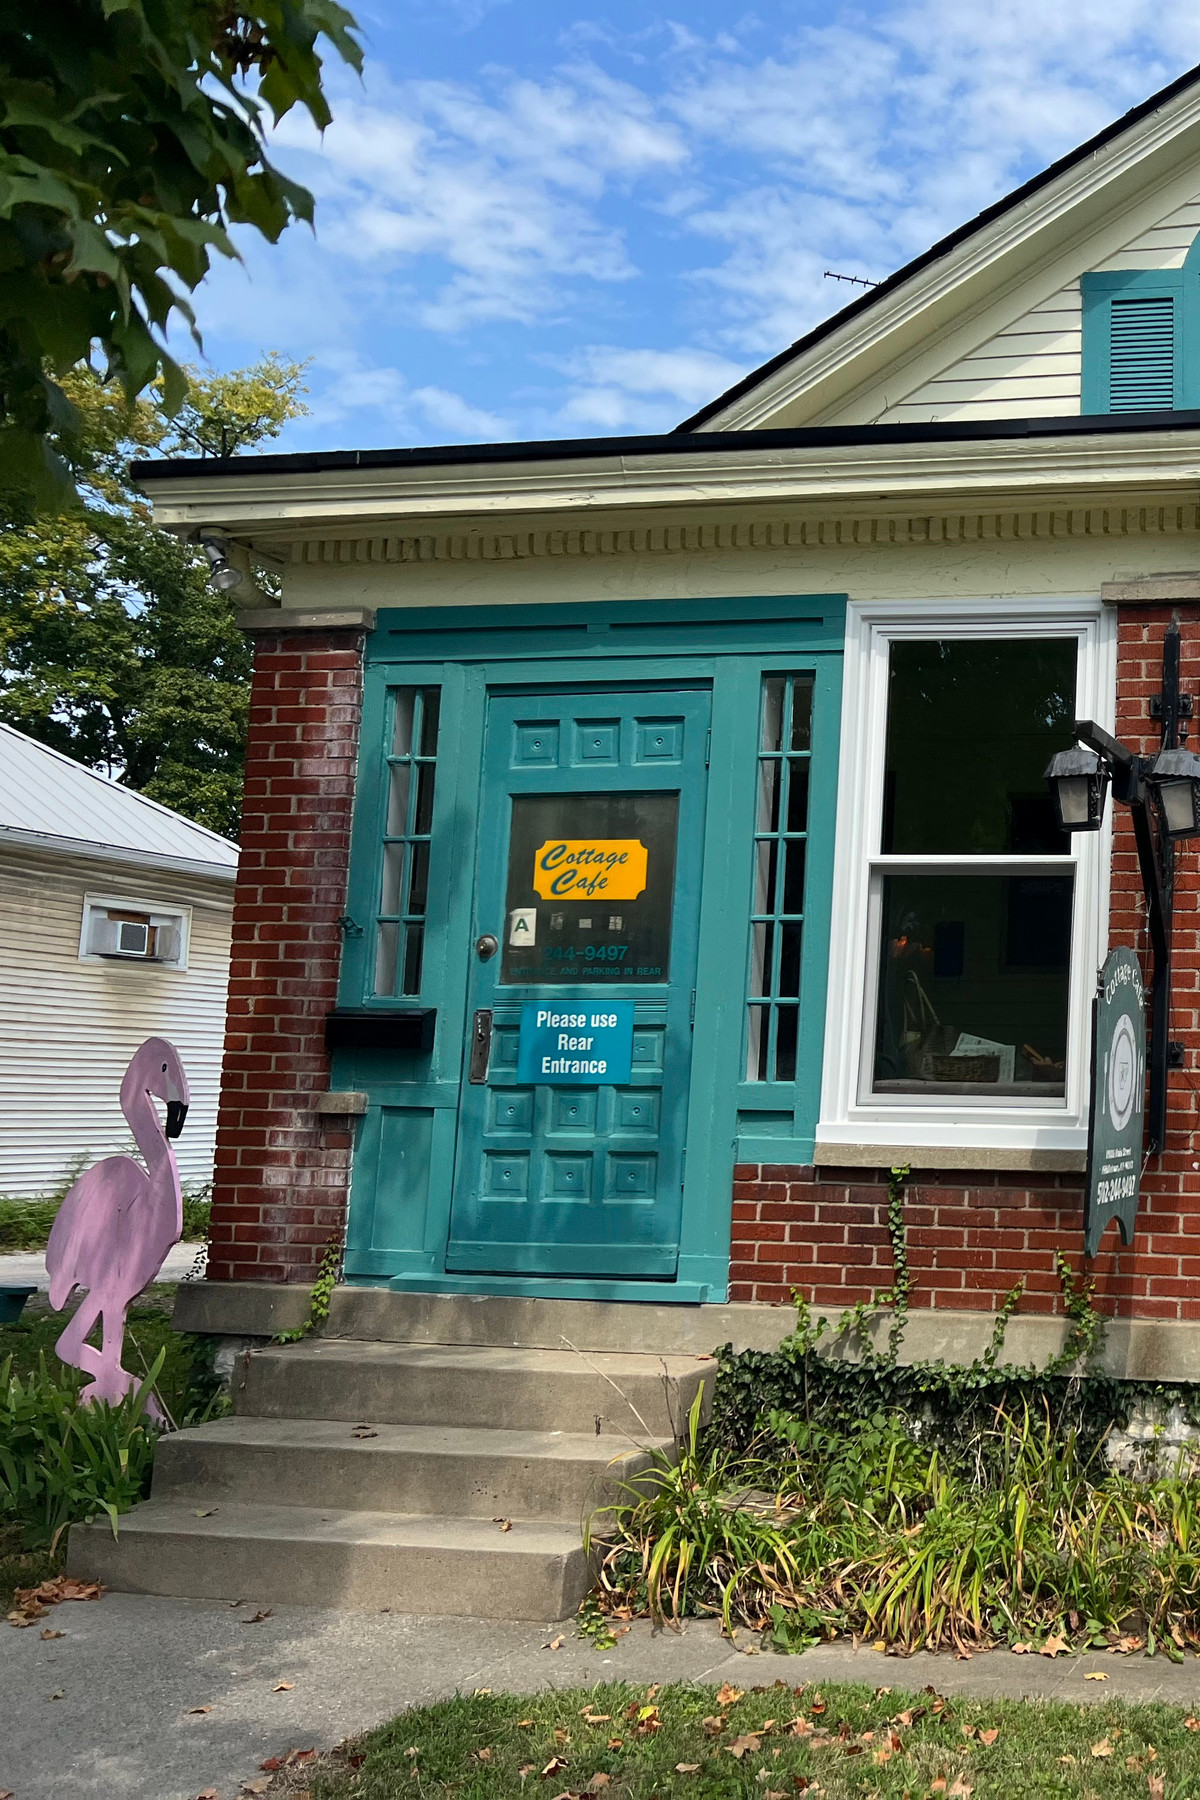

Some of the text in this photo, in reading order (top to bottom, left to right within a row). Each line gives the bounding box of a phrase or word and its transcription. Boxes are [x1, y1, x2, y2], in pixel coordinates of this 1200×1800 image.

[540, 844, 629, 872] Cottage
[550, 868, 608, 896] Cafe
[513, 918, 530, 932] A
[544, 945, 629, 962] 244-9497
[509, 966, 662, 976] ENTCE AND PARKING IN REAR
[1105, 963, 1132, 1005] Cottage
[537, 1010, 618, 1028] Please use
[557, 1034, 594, 1051] Rear
[541, 1056, 607, 1074] Entrance
